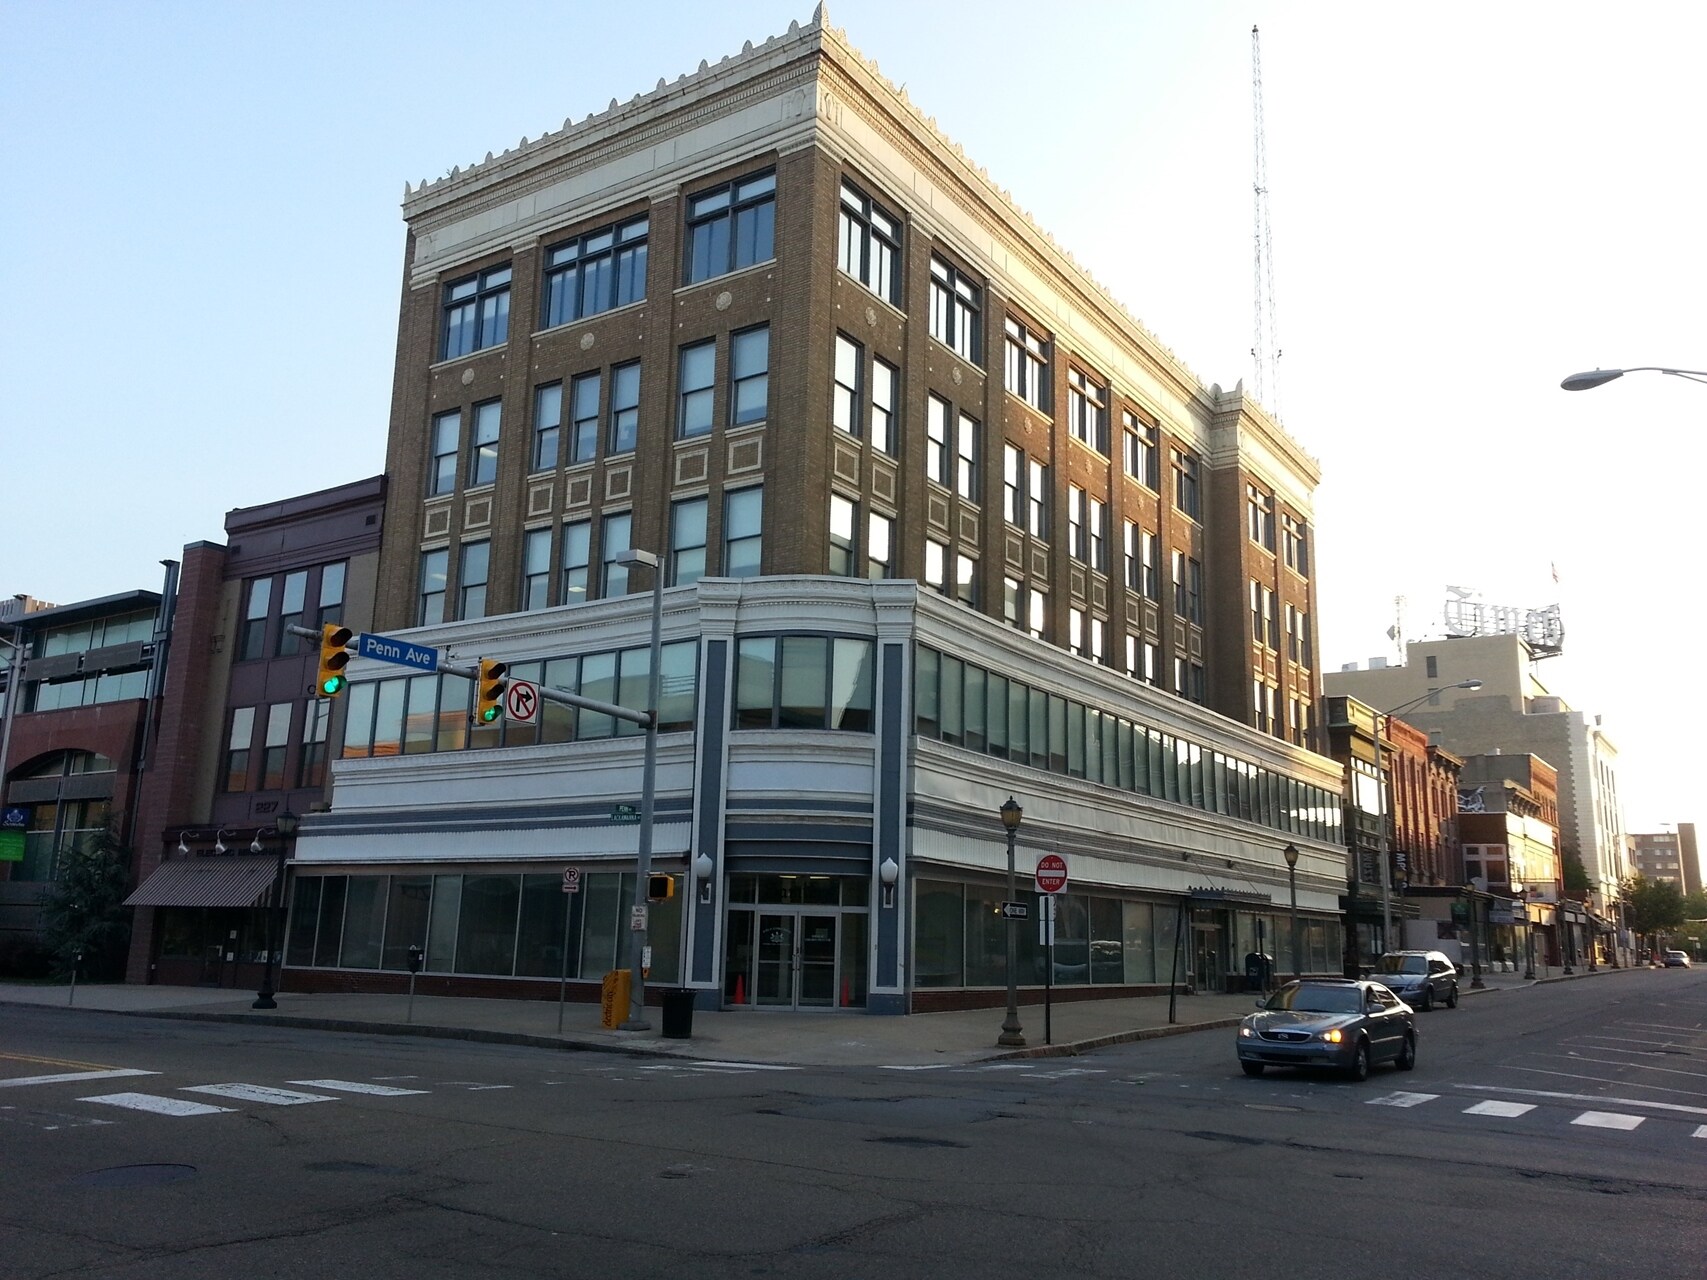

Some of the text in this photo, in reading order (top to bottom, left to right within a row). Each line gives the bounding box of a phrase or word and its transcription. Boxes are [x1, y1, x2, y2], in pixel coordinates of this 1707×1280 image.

[1443, 585, 1566, 649] Times
[366, 638, 431, 665] Penn Ave
[255, 800, 279, 814] 227
[1009, 906, 1017, 914] ONE
